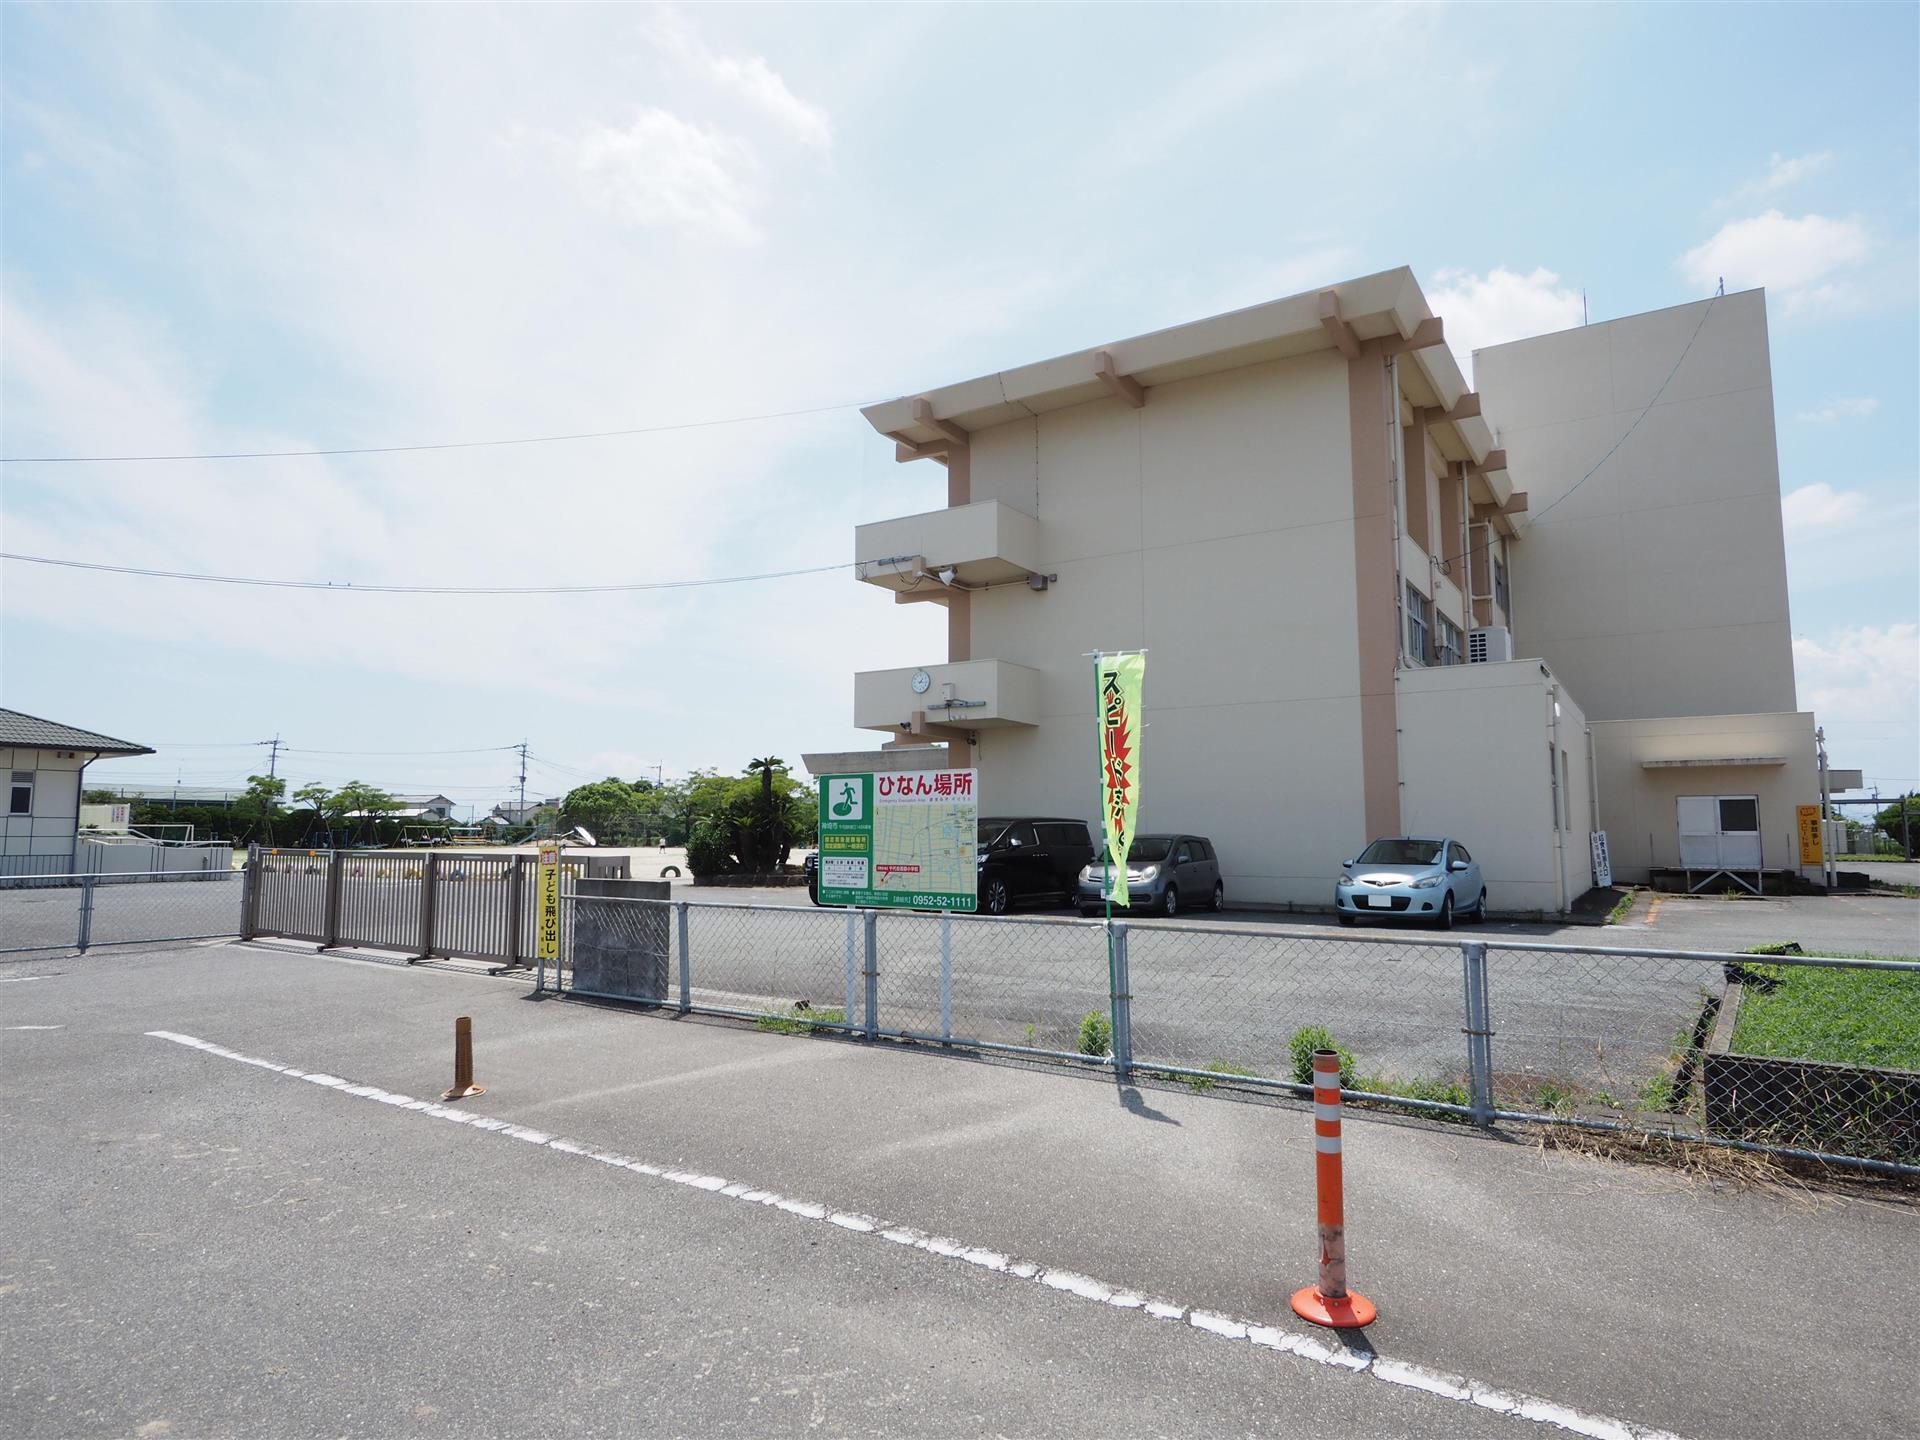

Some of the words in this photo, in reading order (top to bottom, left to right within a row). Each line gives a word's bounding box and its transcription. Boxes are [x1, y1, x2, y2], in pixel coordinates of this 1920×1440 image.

[879, 773, 973, 796] ひなん場所
[545, 869, 556, 954] 子ども飛び出し
